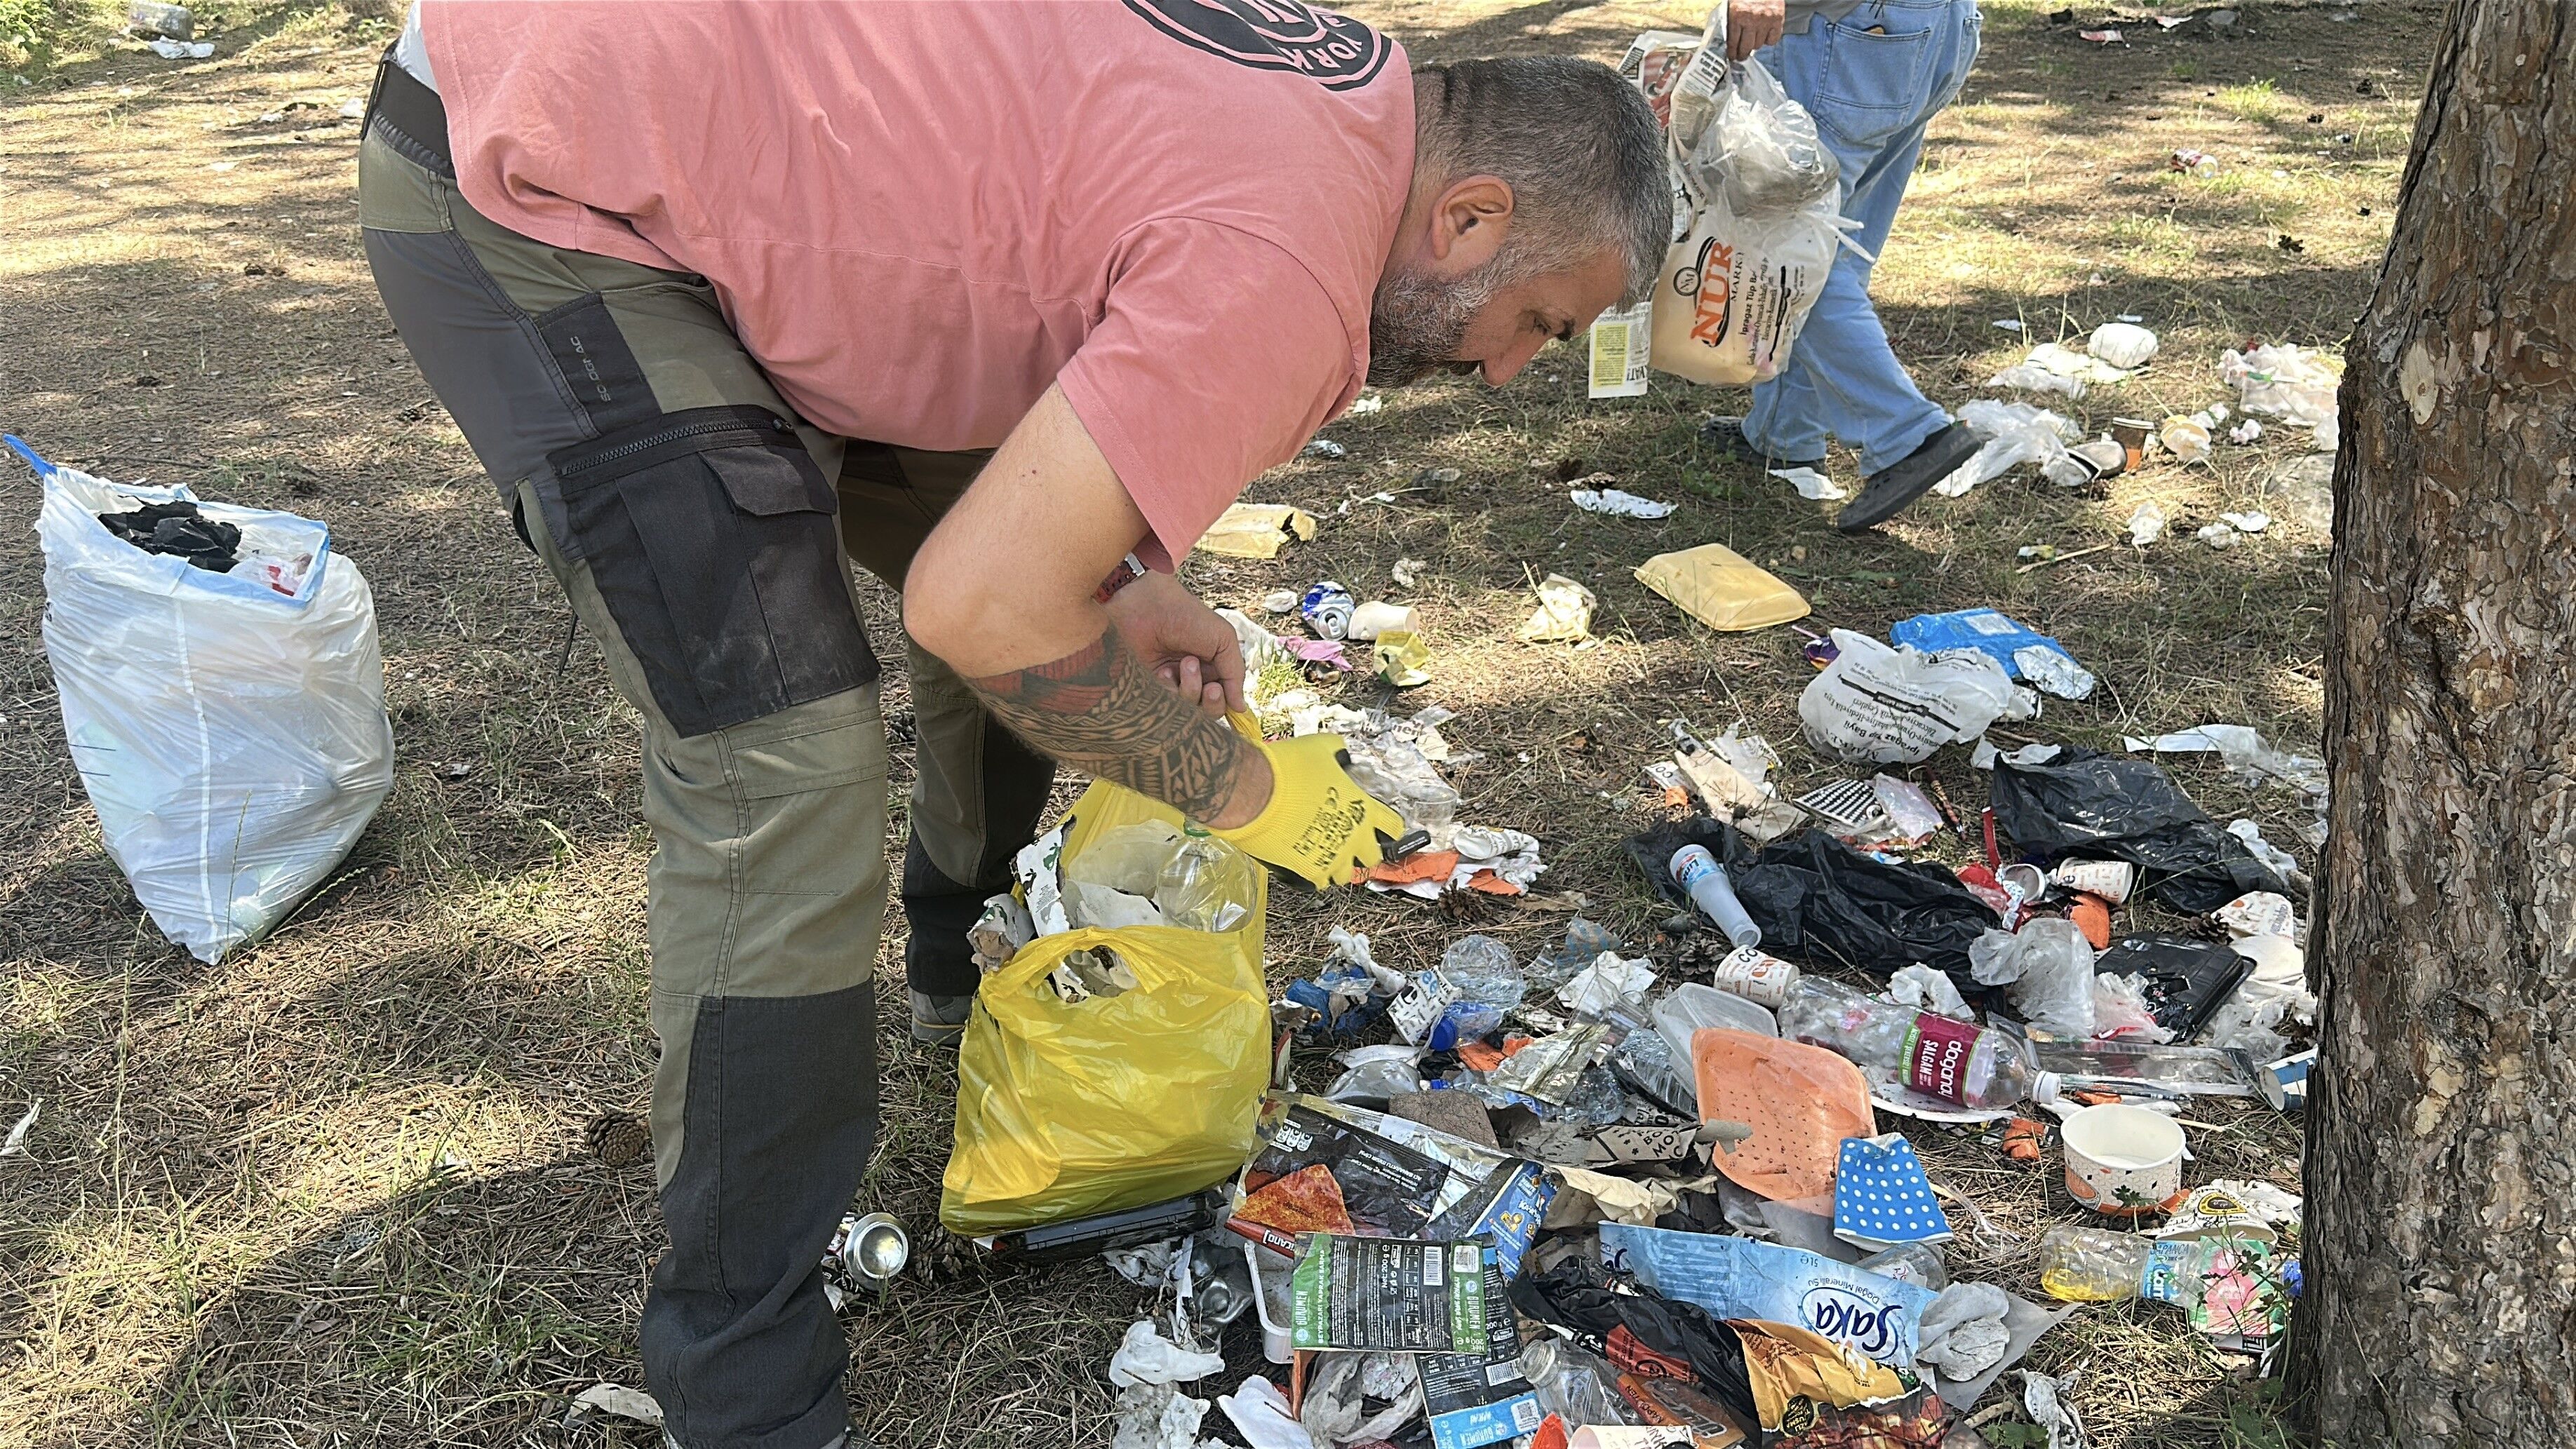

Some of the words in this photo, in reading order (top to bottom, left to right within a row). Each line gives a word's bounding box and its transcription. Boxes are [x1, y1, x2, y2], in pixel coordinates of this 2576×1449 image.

[1277, 34, 1362, 70] YORK
[1690, 241, 1733, 344] NUR
[1729, 251, 1745, 302] MARK
[570, 336, 611, 401] SOOGAC
[1919, 1039, 1939, 1075] ŞALGAM
[1808, 1278, 1823, 1287] Su
[1296, 1290, 1308, 1326] GURUMEN
[1467, 1295, 1481, 1330] GURUMEN
[1816, 1298, 1903, 1352] Saka
[1625, 1384, 1664, 1424] NAPOLTEN
